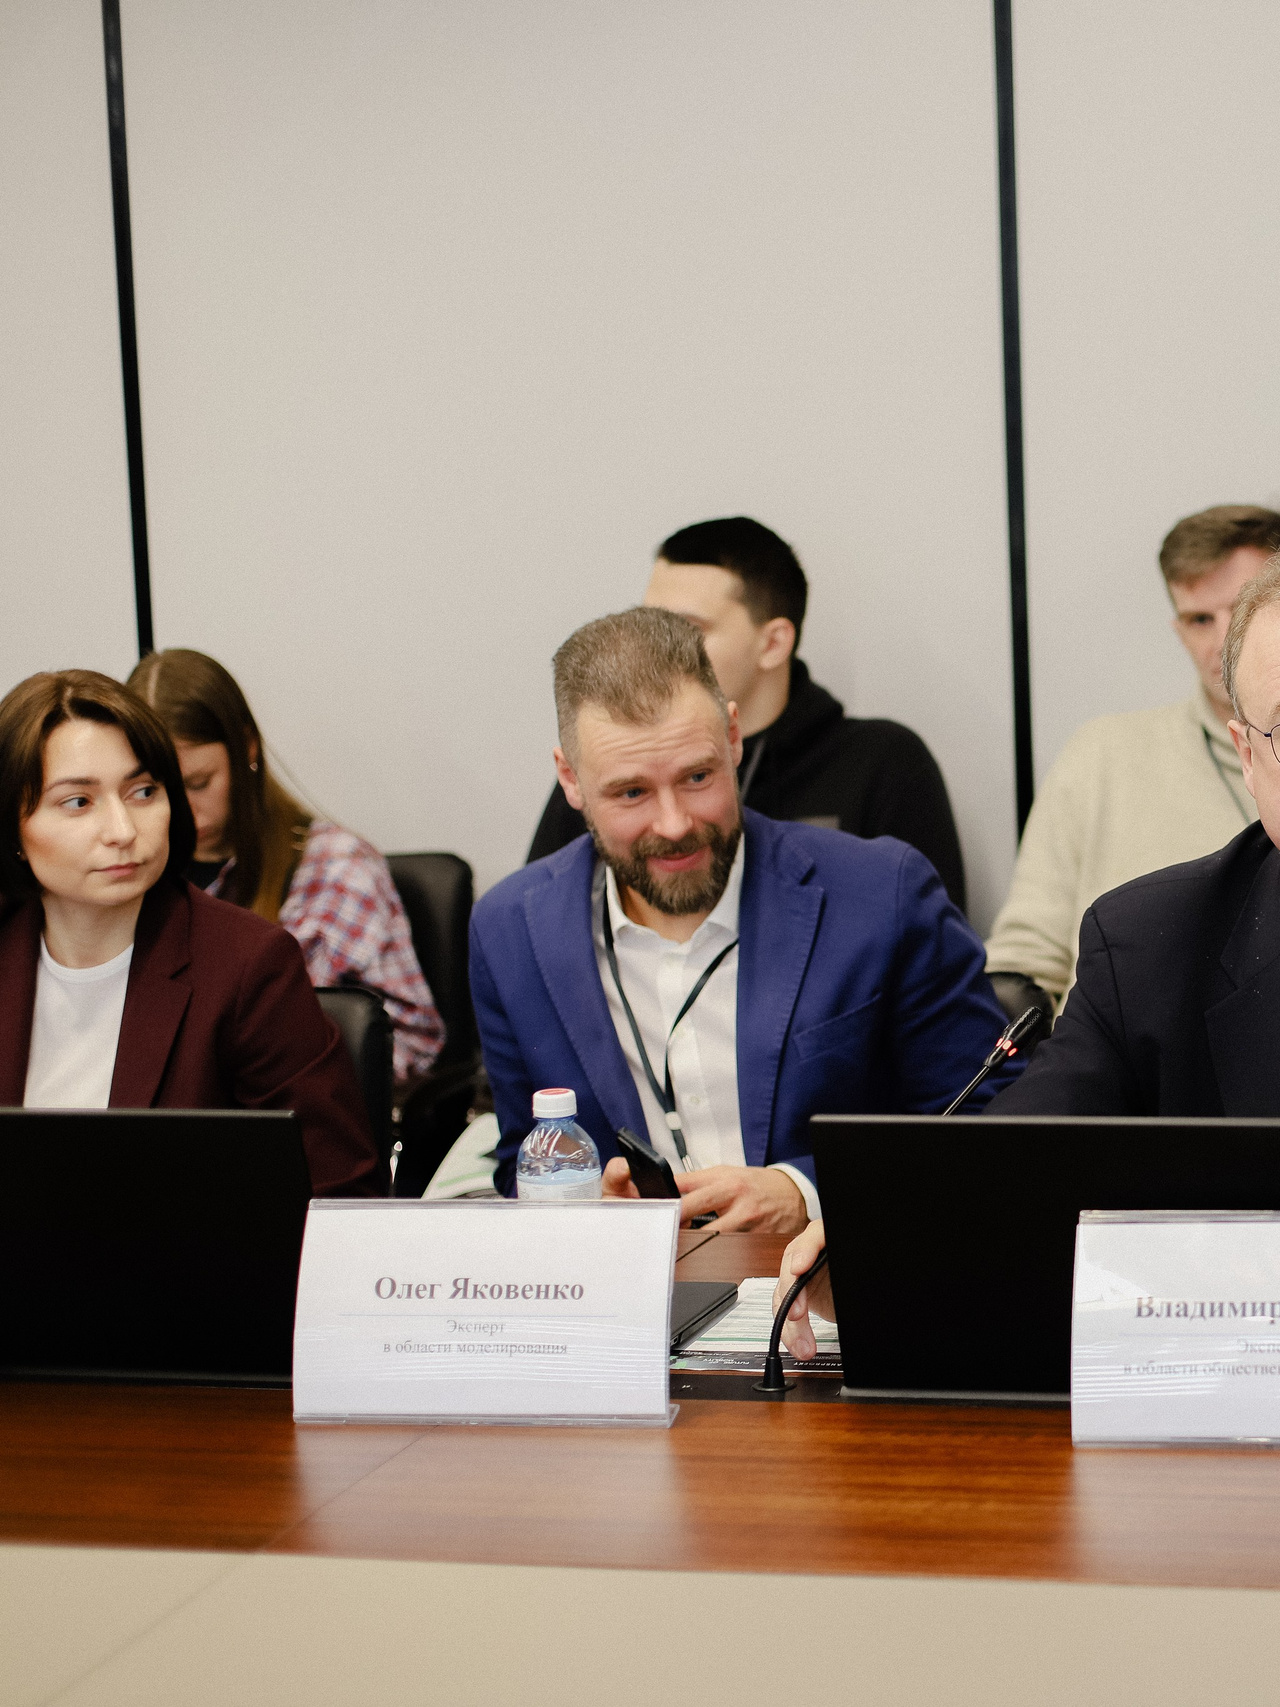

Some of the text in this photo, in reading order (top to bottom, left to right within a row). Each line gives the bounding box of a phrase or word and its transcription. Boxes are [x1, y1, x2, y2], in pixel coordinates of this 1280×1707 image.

[374, 1276, 585, 1300] Олег Яковенко
[446, 1320, 506, 1336] Эксперт
[383, 1340, 568, 1358] в области моделирования
[1136, 1361, 1199, 1376] области
